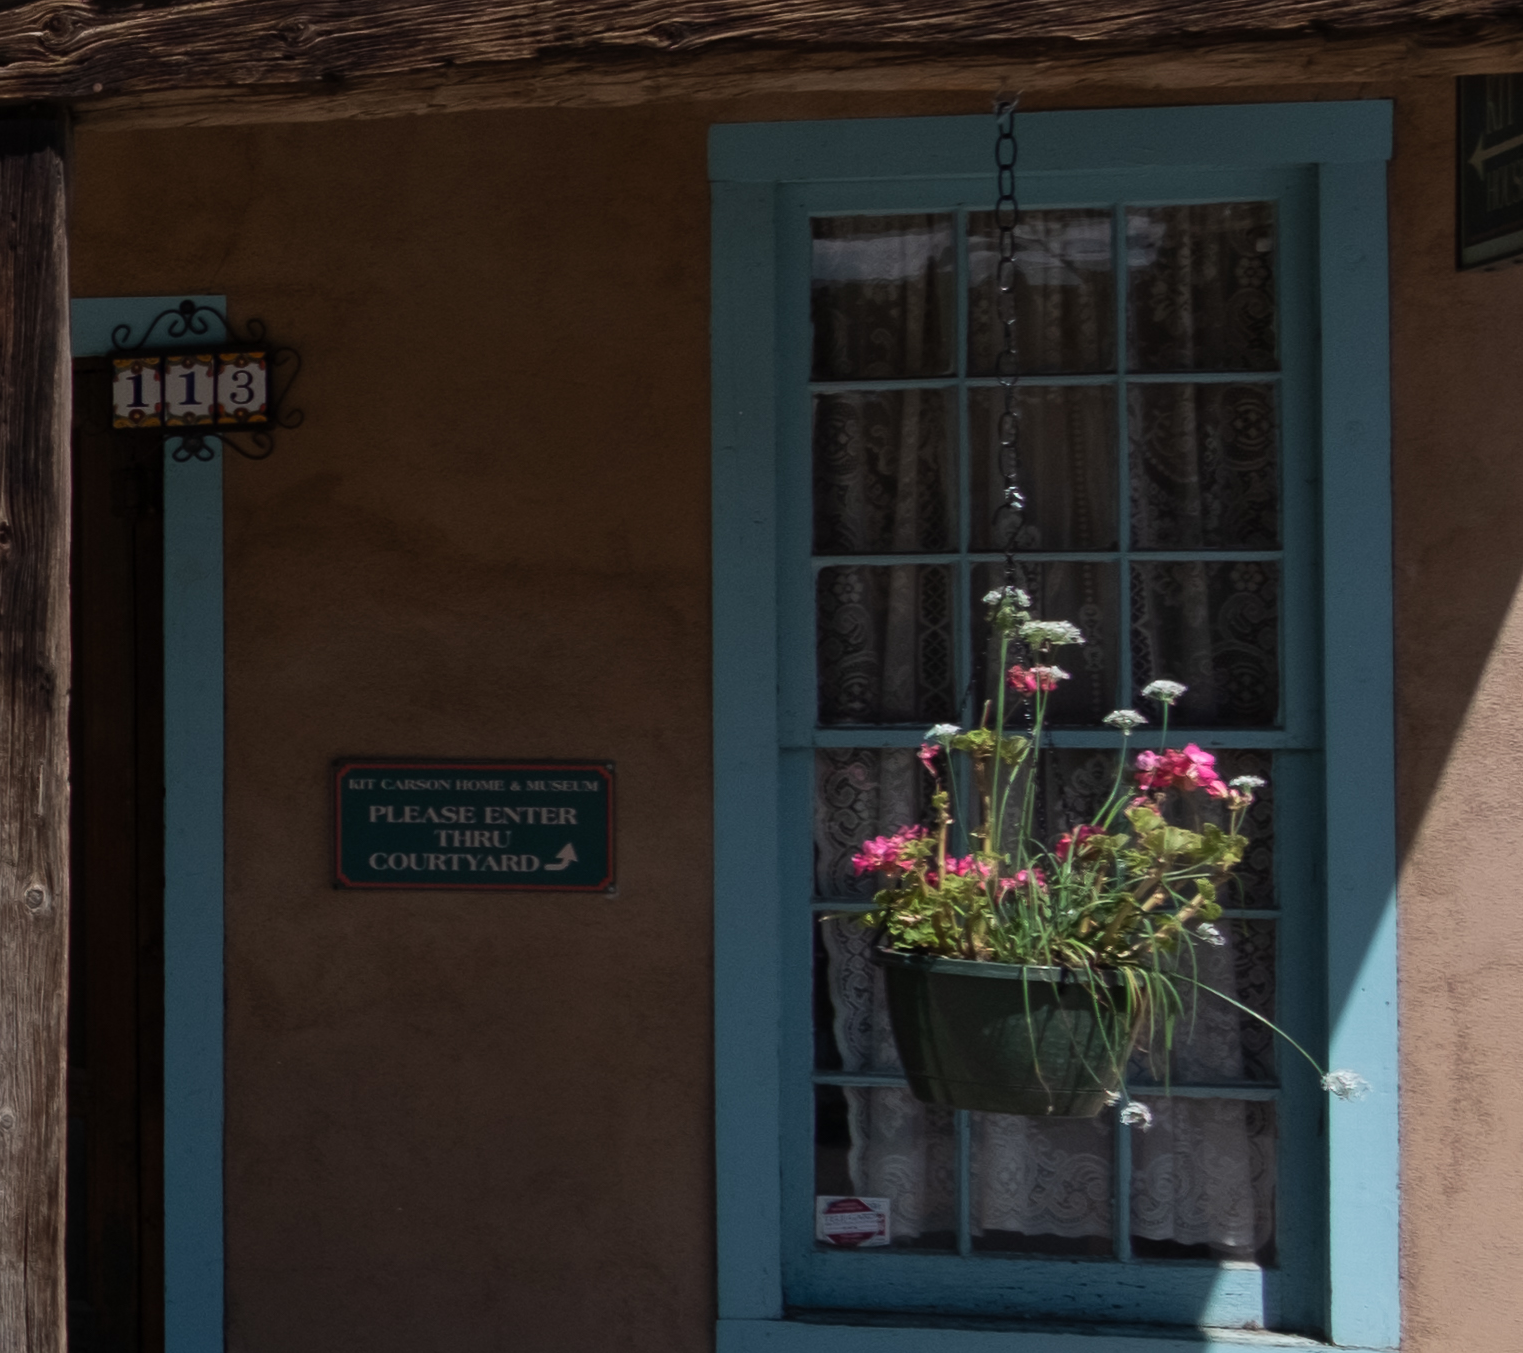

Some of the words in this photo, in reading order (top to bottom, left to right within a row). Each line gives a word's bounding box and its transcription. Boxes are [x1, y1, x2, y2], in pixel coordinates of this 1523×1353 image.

[126, 370, 254, 408] 113
[348, 778, 374, 790] KIT
[380, 779, 453, 791] CARSON
[455, 779, 505, 792] HOME
[509, 780, 522, 792] &
[526, 780, 599, 792] MUSEUM
[368, 805, 476, 825] PLEASE
[484, 806, 578, 826] ENTER
[434, 829, 512, 848] THRU
[368, 851, 540, 872] COURTYARD
